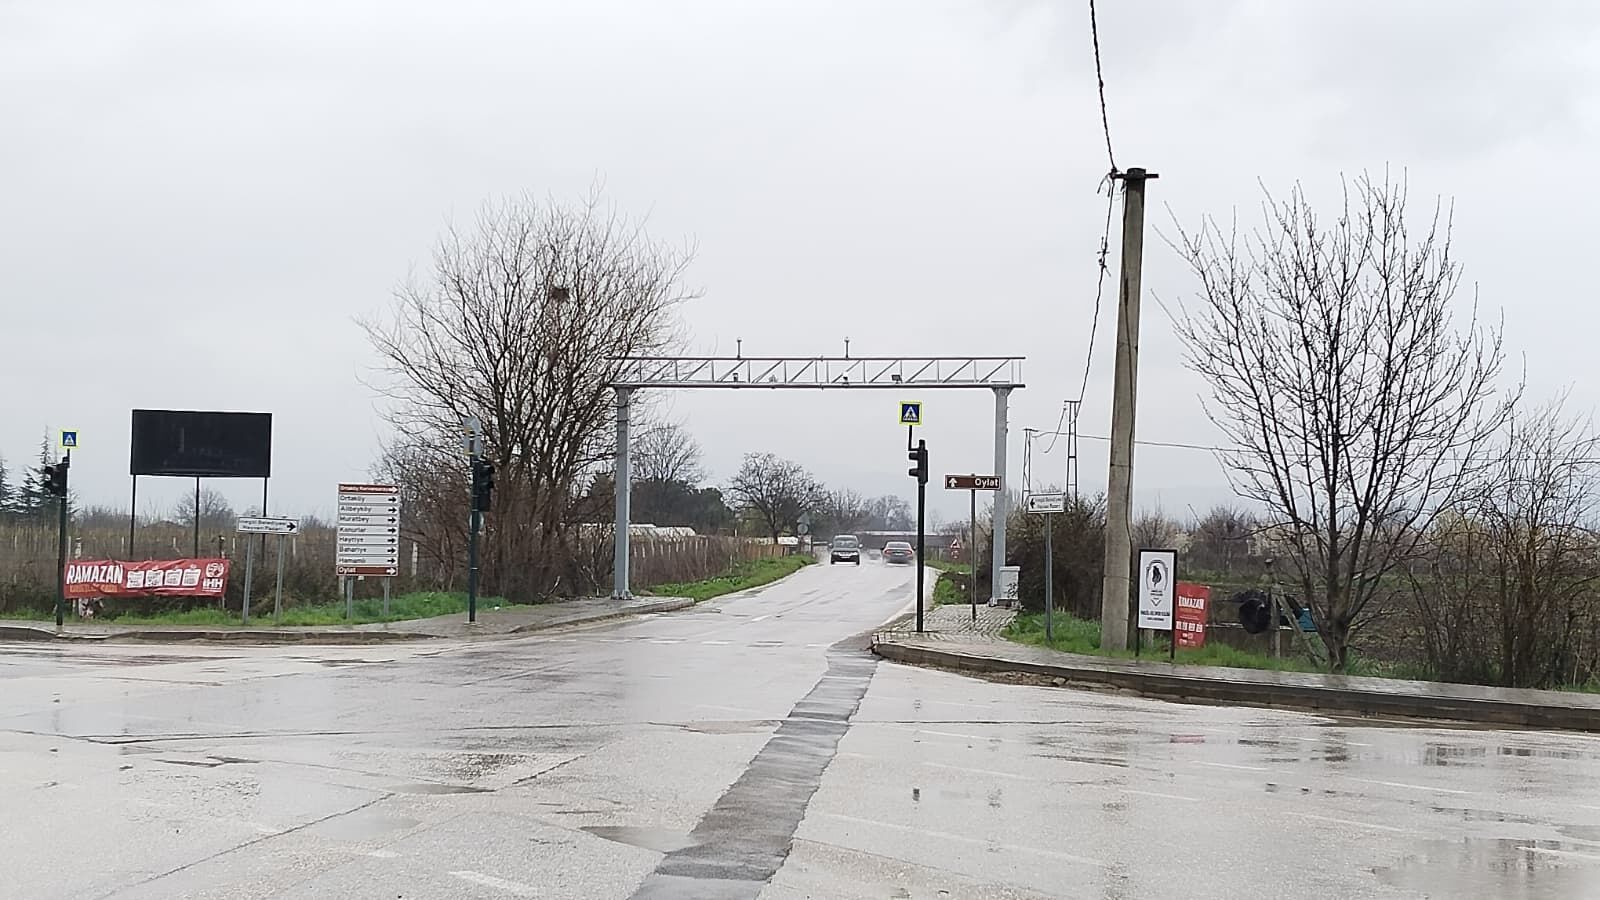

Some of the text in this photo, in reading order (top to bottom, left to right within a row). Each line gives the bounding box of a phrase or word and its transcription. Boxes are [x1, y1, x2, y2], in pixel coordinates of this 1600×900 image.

[975, 478, 999, 489] Oylat
[66, 564, 124, 585] RAMAZAN
[339, 566, 356, 574] Oylat
